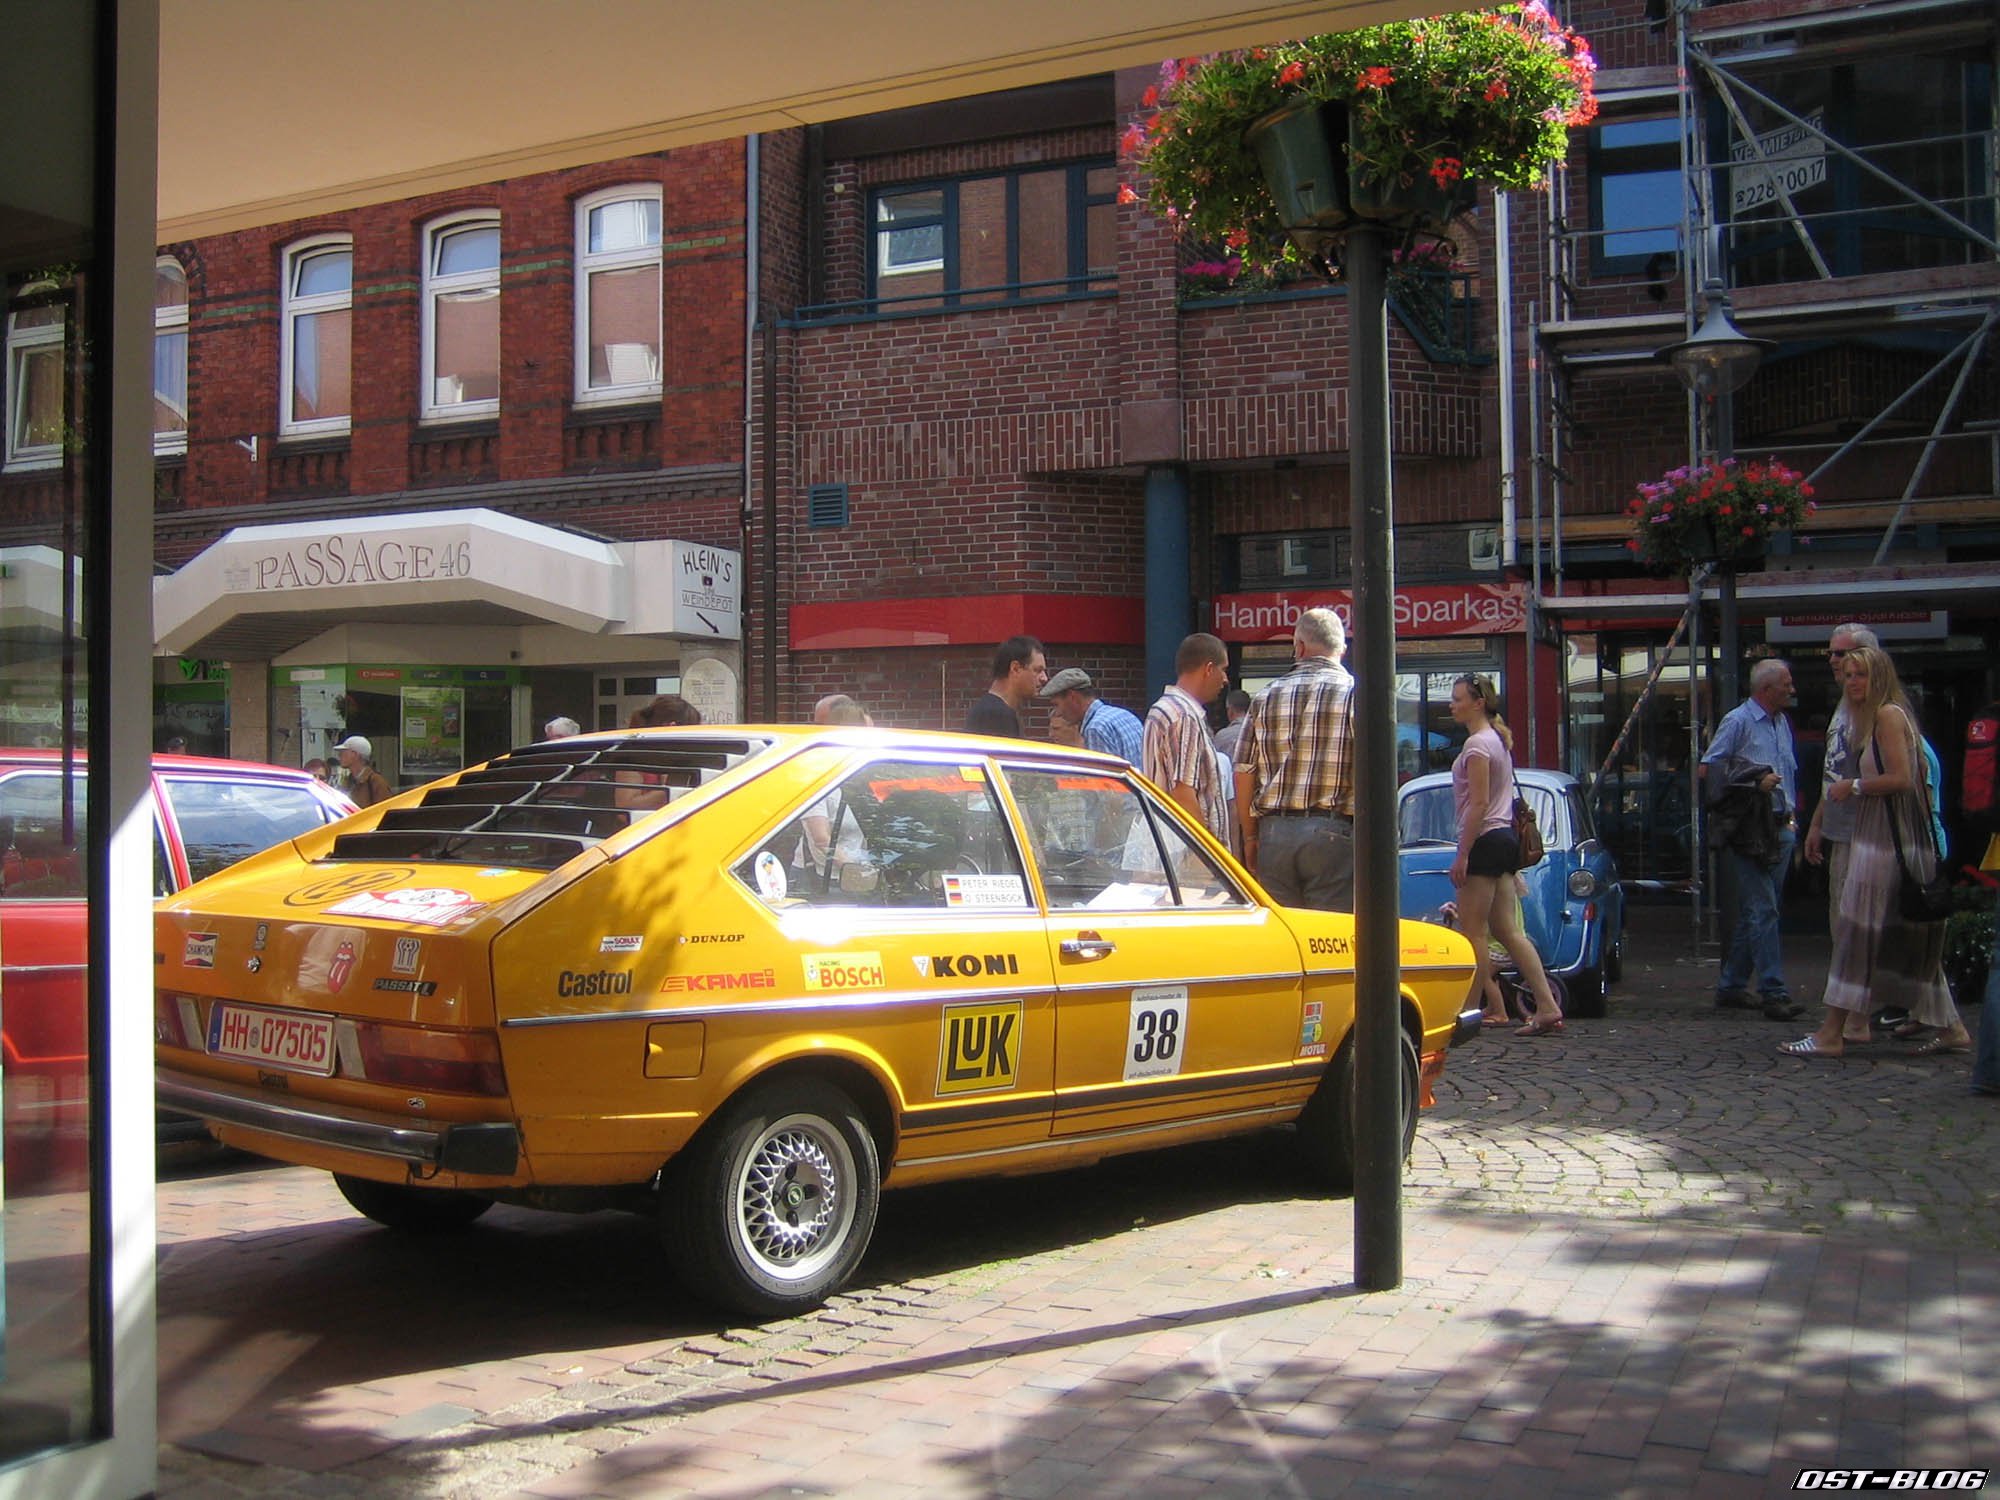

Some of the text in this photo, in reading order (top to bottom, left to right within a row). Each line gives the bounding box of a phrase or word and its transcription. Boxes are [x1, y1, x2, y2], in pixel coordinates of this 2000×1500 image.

[1732, 115, 1823, 162] VEMIETUNG
[255, 535, 436, 590] PASSAGE
[439, 540, 471, 577] 46
[1393, 591, 1530, 629] Sparkass
[690, 934, 745, 944] DUNLOP
[1309, 937, 1349, 955] BOSCH
[820, 965, 883, 988] BOSCH
[932, 952, 1019, 978] KONI
[375, 979, 422, 993] PASSAT
[558, 968, 633, 998] Castrol
[223, 1011, 328, 1062] HH 07505
[1133, 1008, 1179, 1063] 38
[1299, 1043, 1327, 1057] MOTUL
